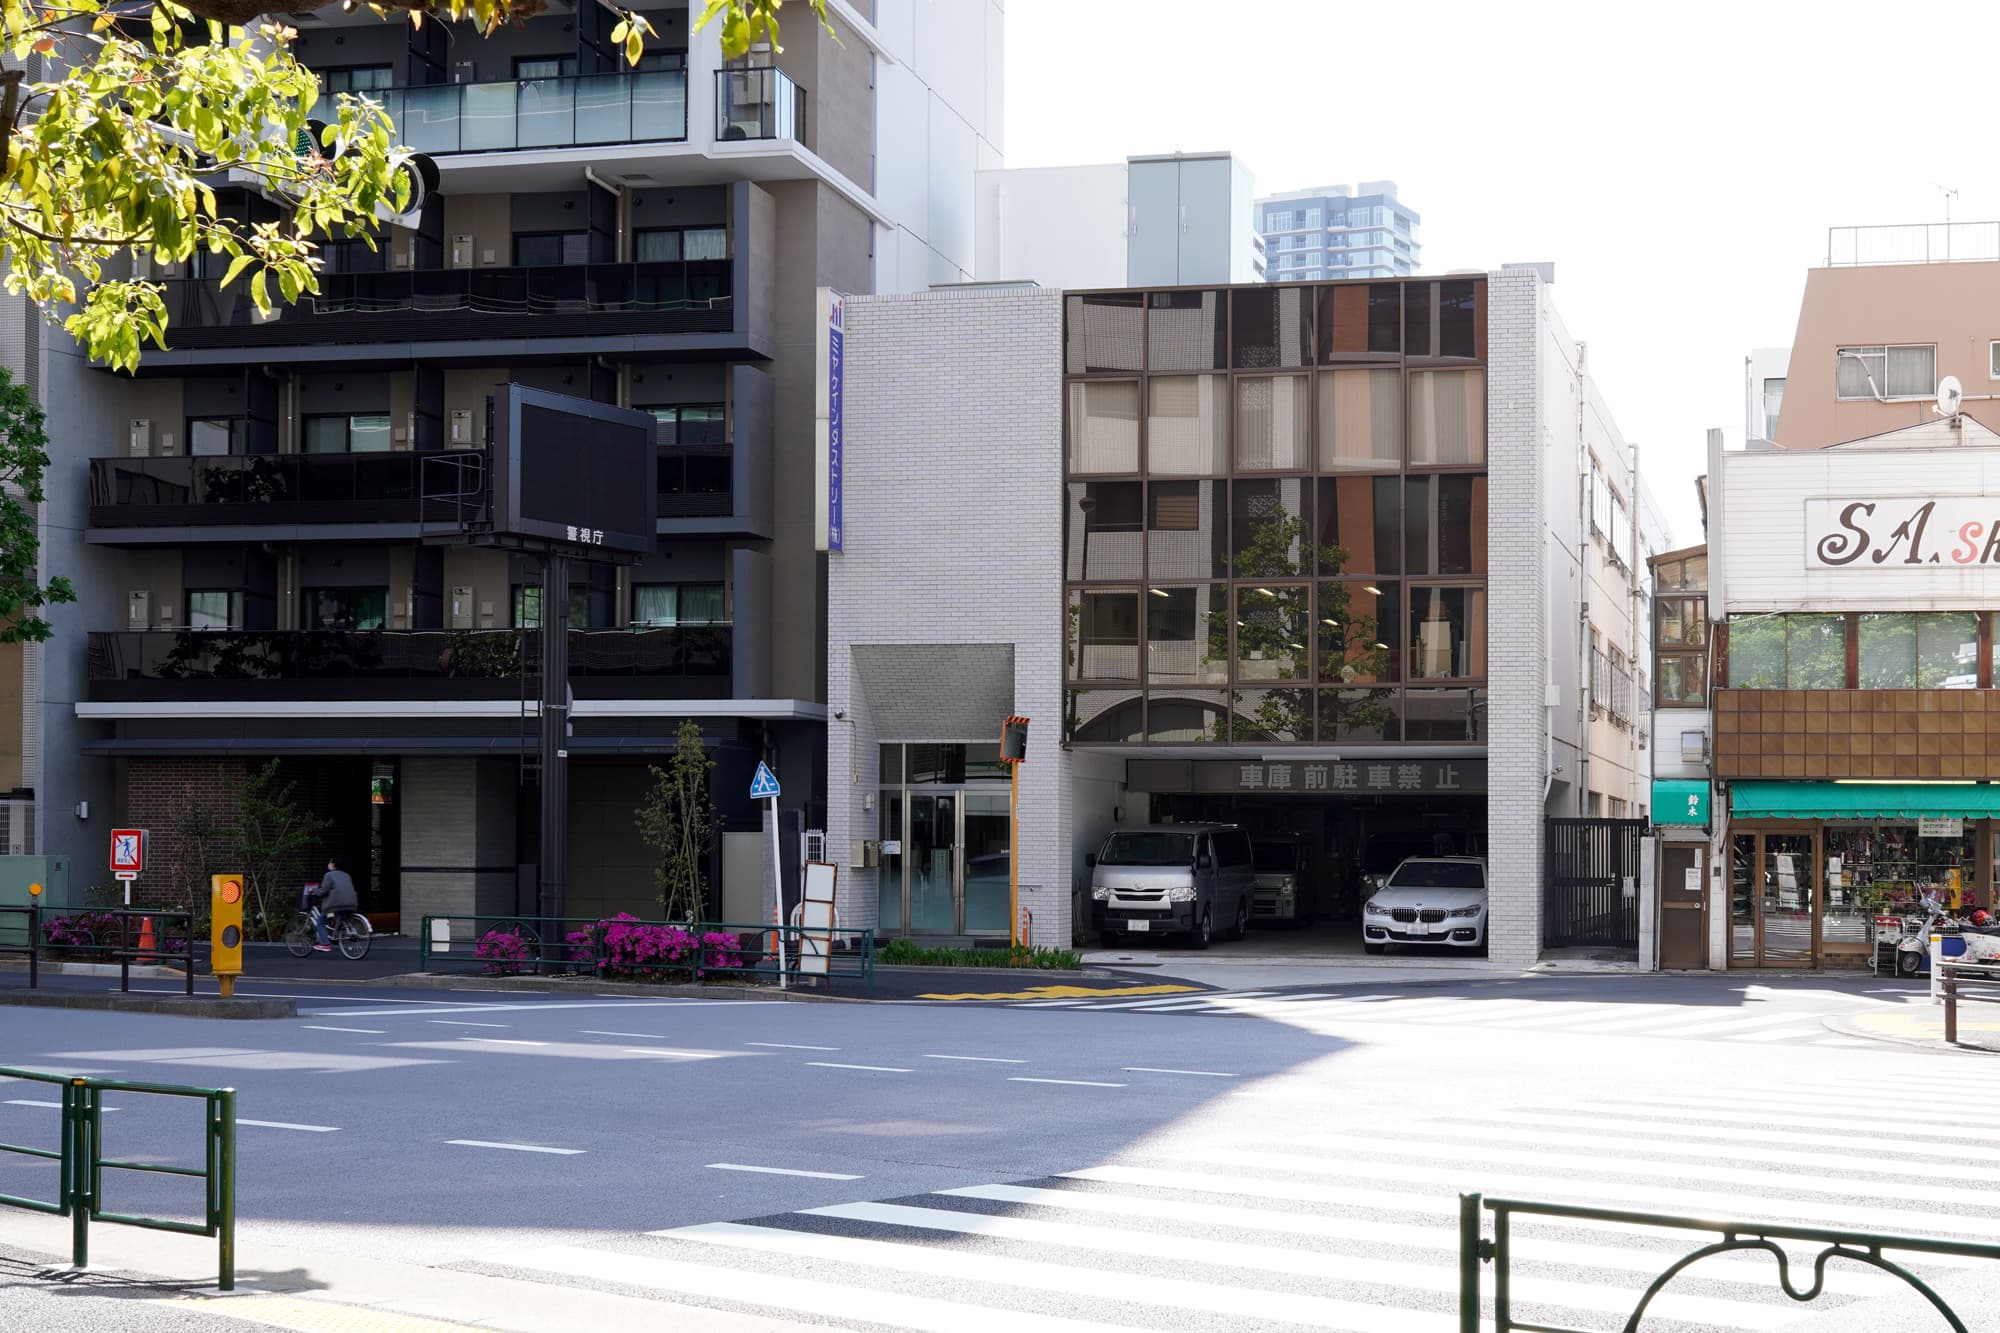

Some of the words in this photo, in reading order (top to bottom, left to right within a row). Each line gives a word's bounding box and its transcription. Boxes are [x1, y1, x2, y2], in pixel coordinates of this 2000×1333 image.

[564, 525, 604, 546] 警視庁
[1240, 764, 1460, 789] 車庫前駐車禁止
